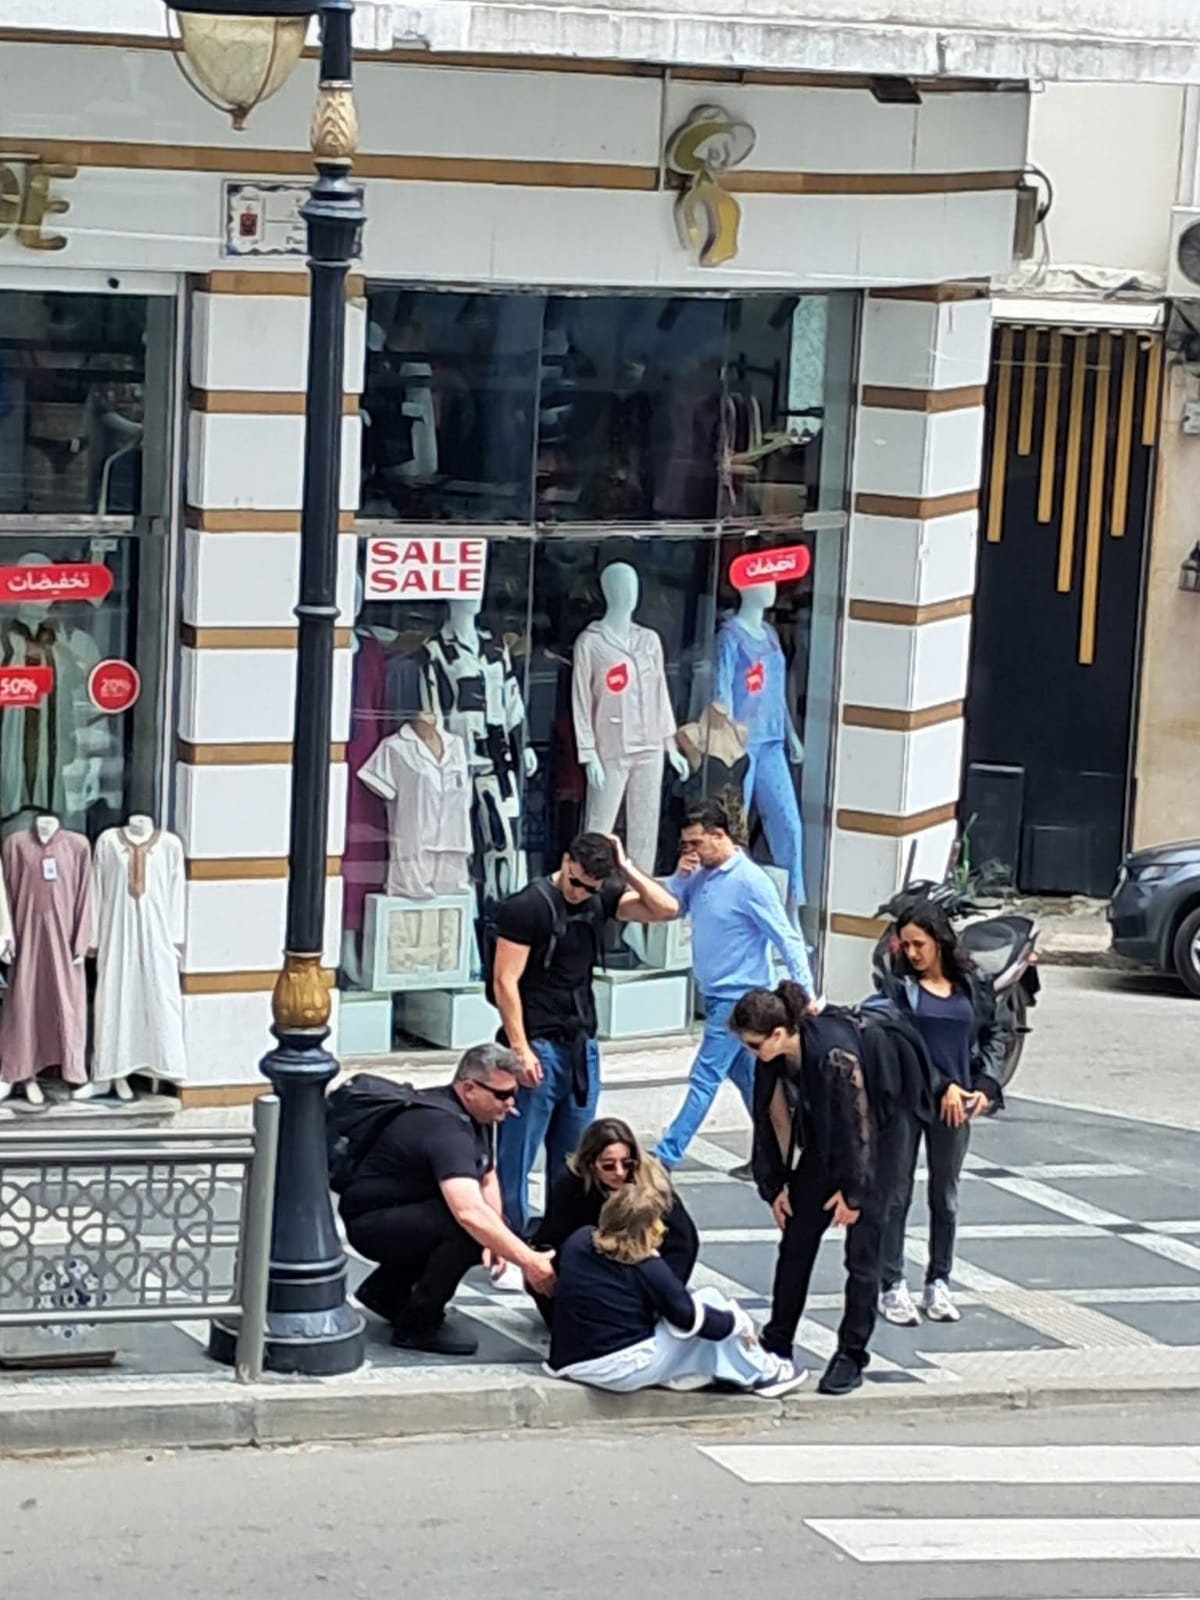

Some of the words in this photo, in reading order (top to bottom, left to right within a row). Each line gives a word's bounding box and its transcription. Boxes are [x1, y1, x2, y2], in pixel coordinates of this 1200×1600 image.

[371, 541, 482, 564] SALE
[7, 571, 90, 594] تخفيضات
[370, 569, 481, 593] SALE
